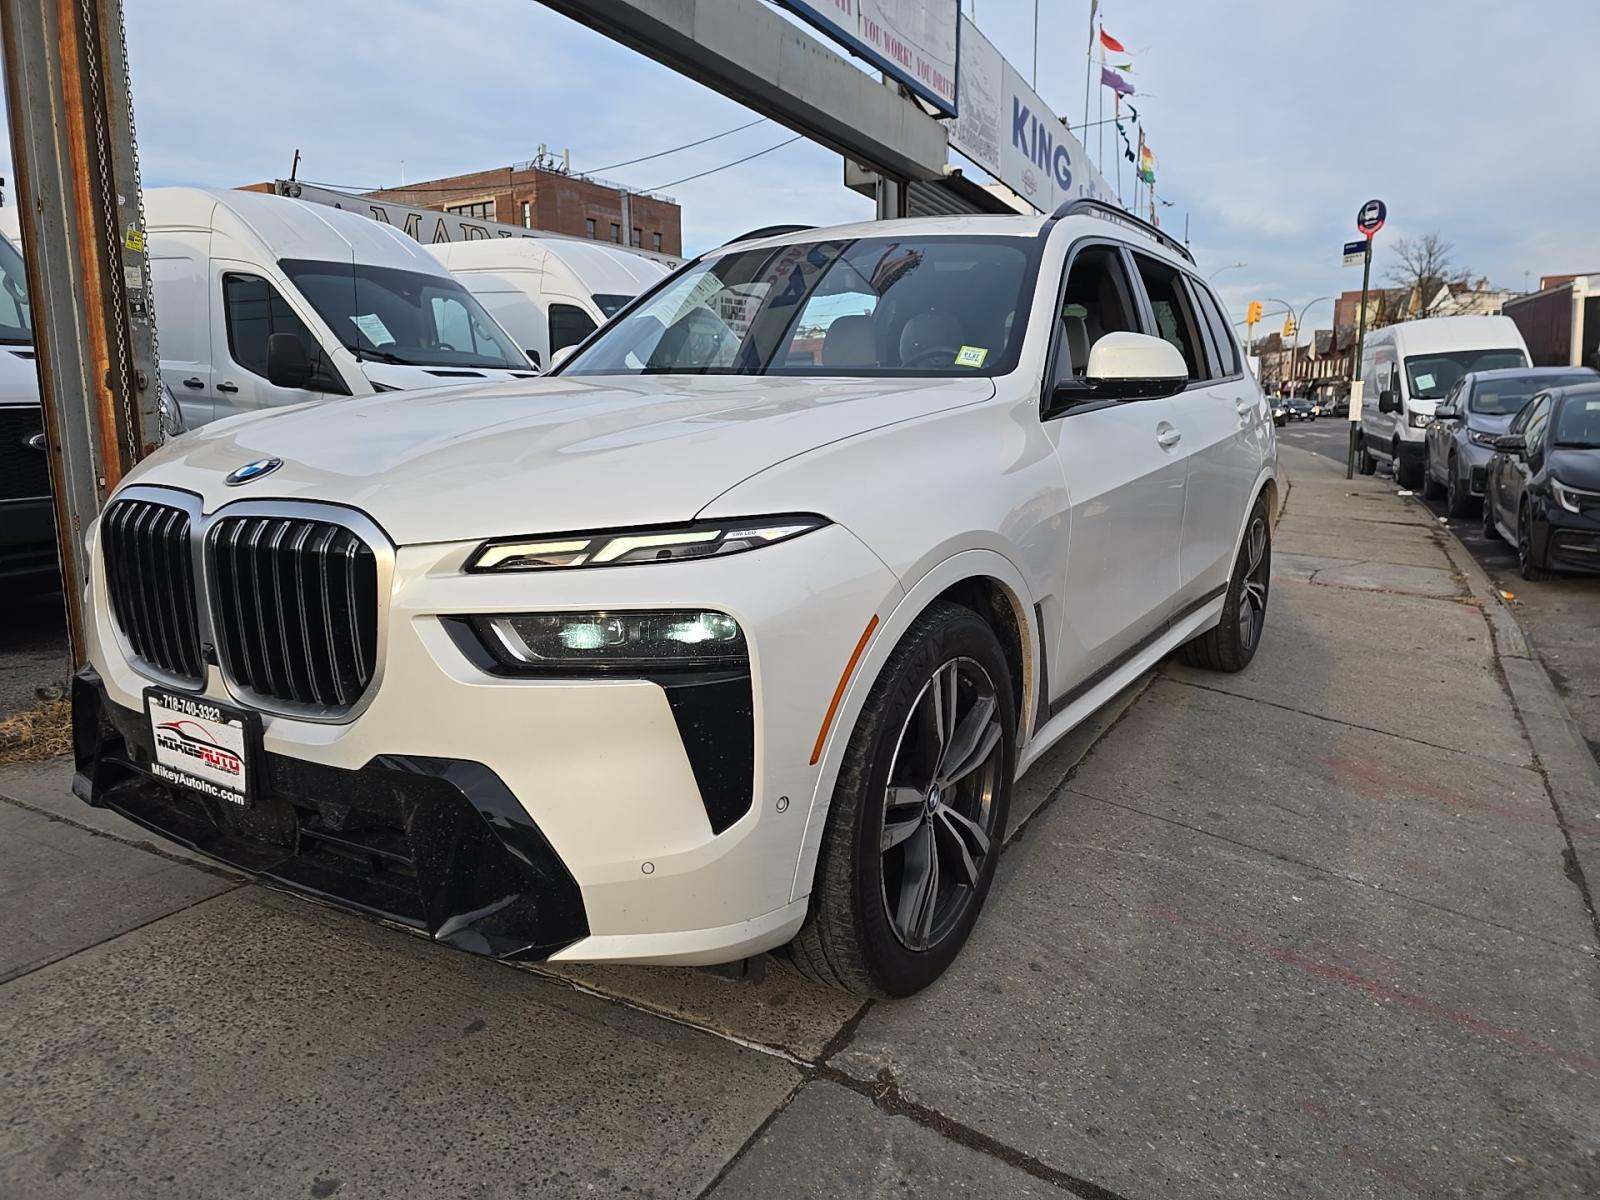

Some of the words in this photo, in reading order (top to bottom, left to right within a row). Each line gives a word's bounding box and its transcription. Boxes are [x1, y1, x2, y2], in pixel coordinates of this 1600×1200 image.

[864, 15, 881, 46] YOU
[884, 32, 913, 70] WORK!
[917, 57, 932, 83] YOU
[1012, 95, 1073, 192] KING
[151, 762, 245, 806] MikeyAutoInc.com
